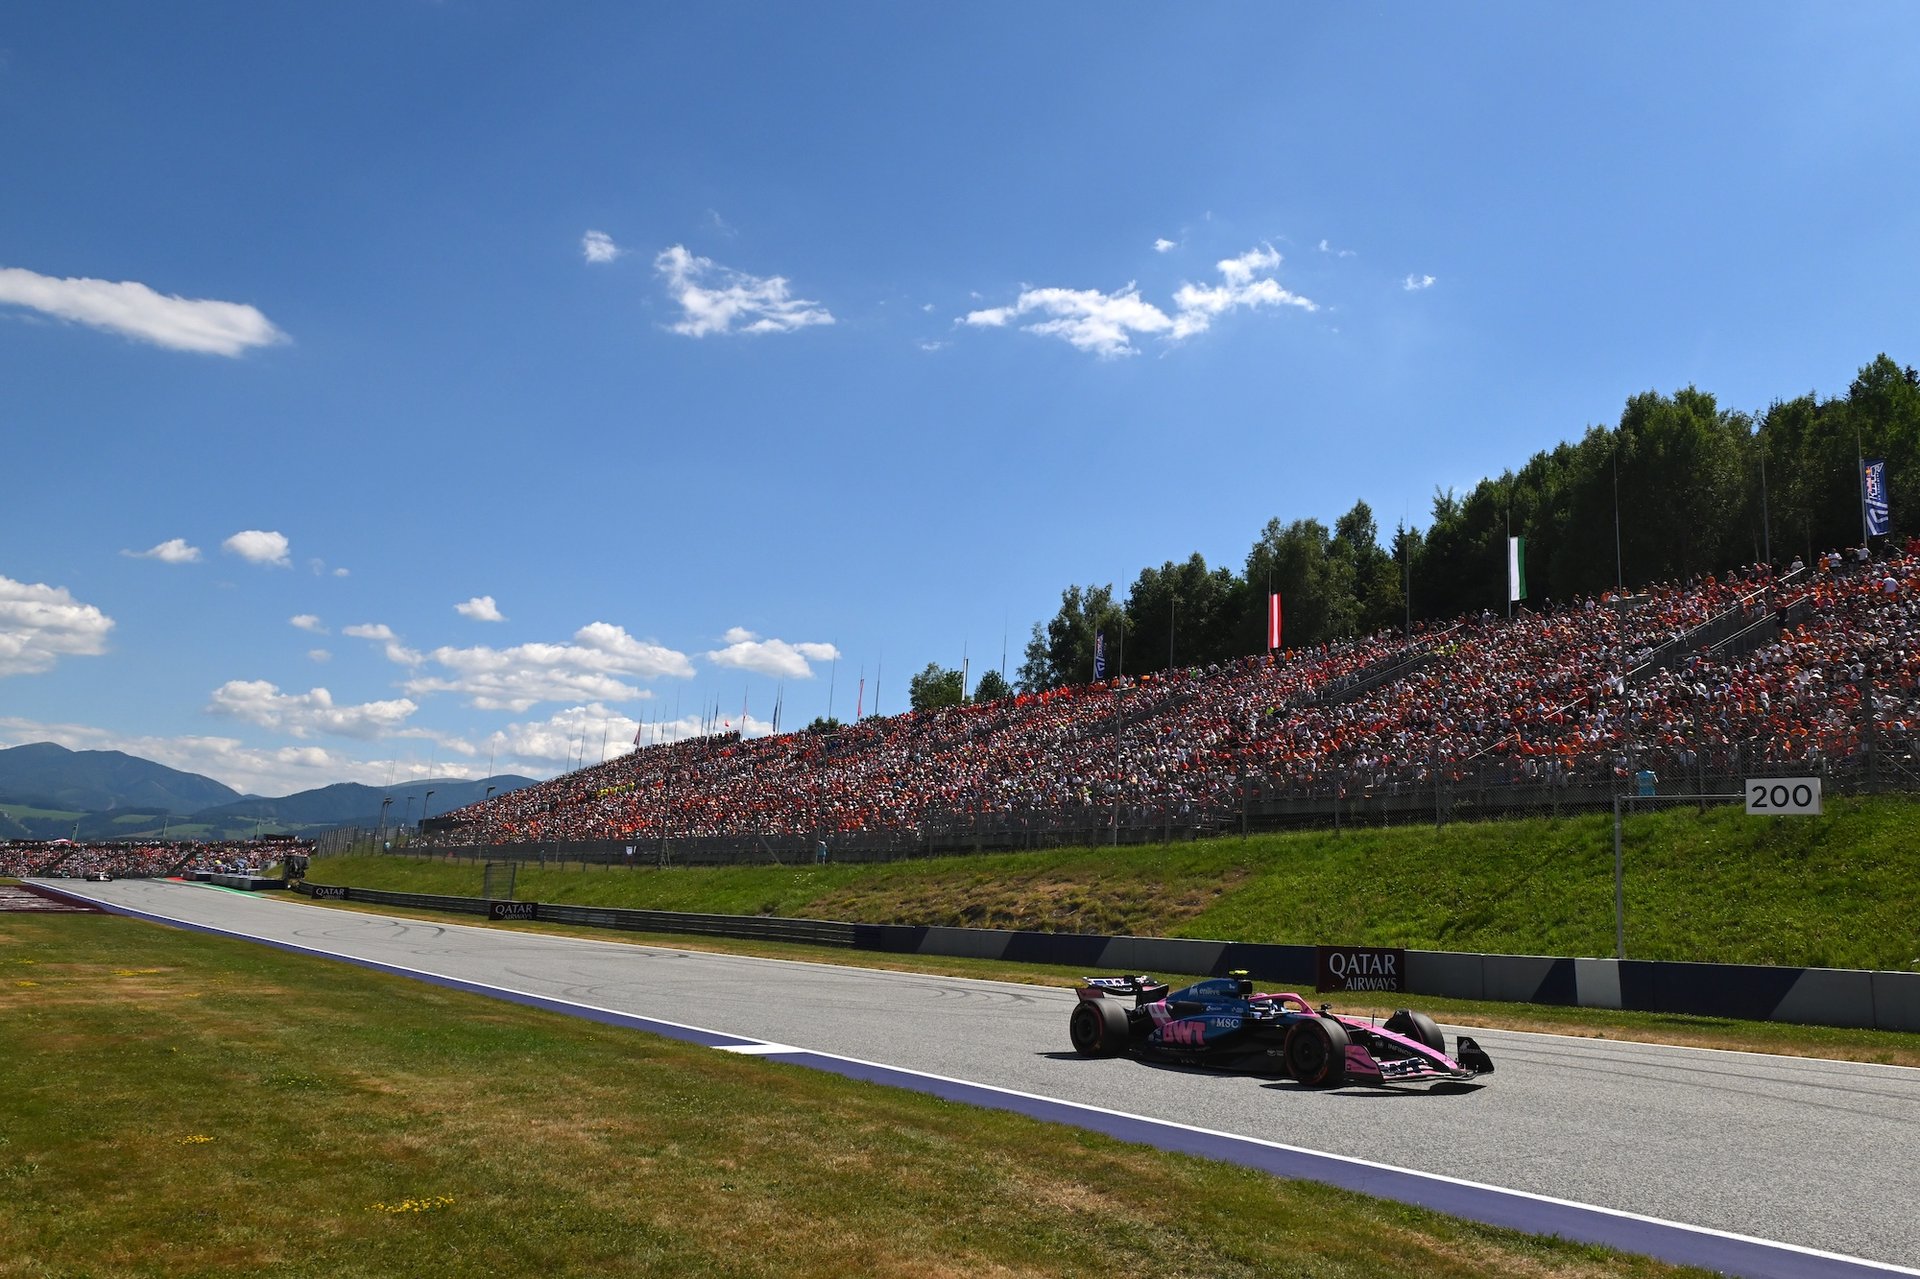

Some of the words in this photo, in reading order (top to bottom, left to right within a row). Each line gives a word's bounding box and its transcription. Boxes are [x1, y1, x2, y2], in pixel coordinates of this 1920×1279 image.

[1751, 784, 1812, 808] 200
[316, 888, 345, 896] QATAR
[495, 904, 533, 915] QATAR
[1329, 952, 1397, 980] QATAR
[1345, 977, 1397, 991] AIRWAYS
[1216, 1018, 1239, 1028] MSC
[1162, 1021, 1206, 1046] BWT
